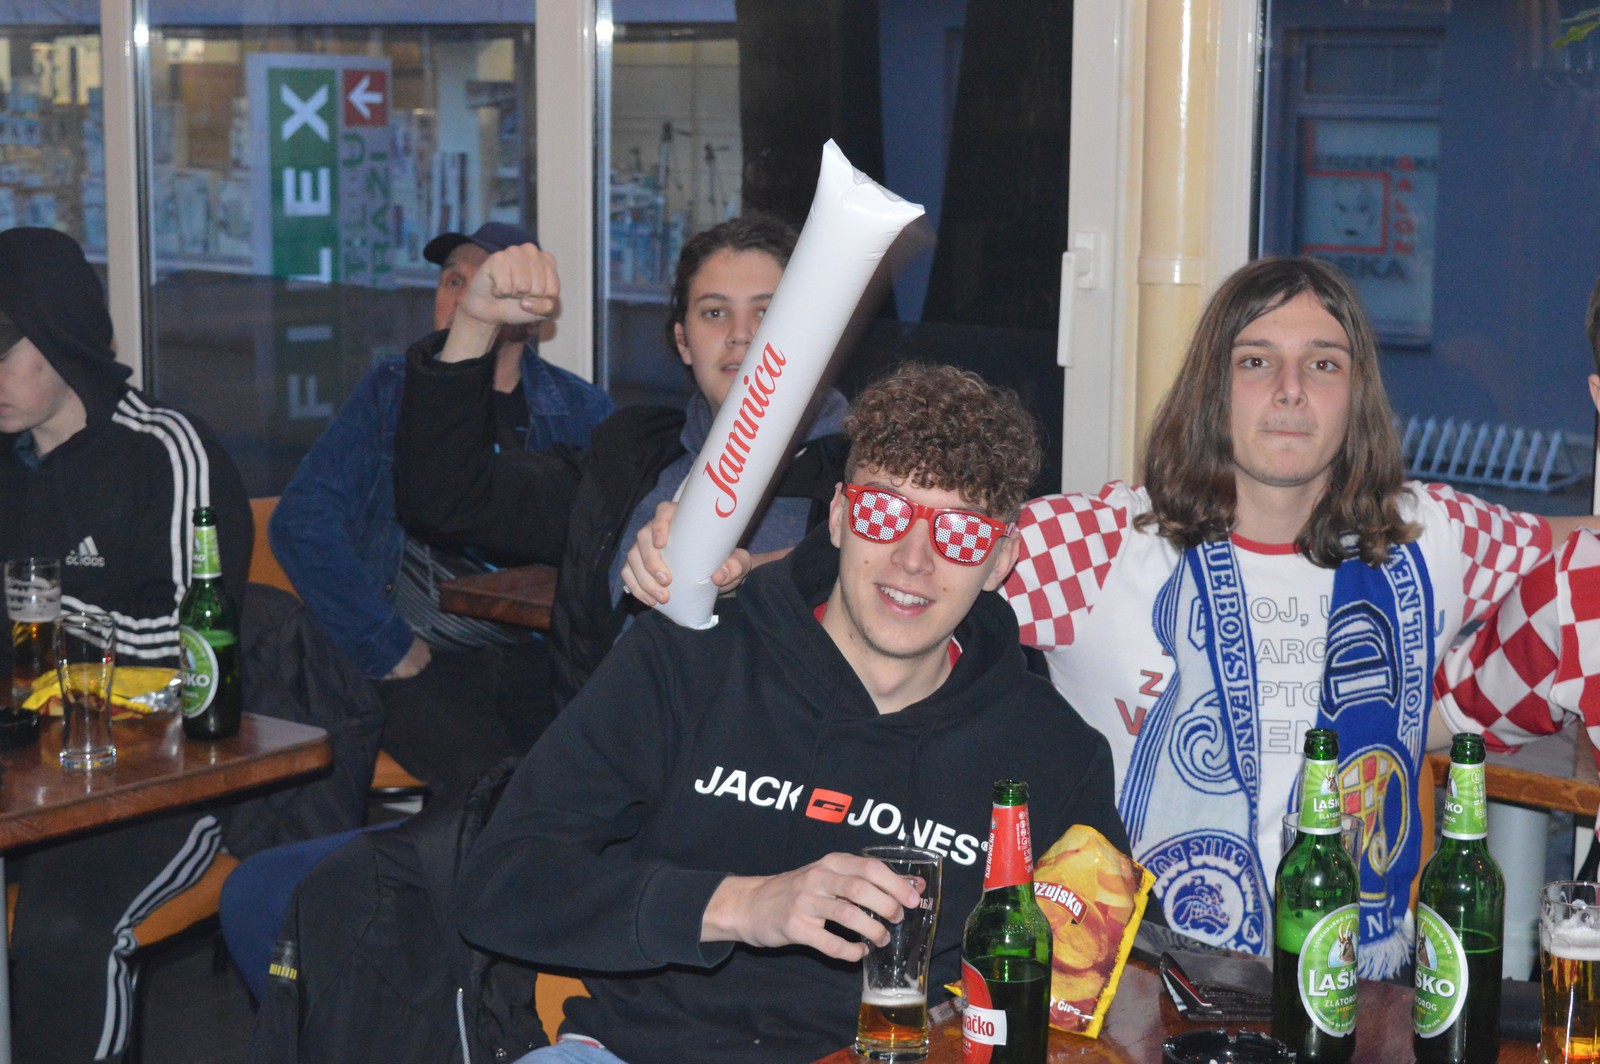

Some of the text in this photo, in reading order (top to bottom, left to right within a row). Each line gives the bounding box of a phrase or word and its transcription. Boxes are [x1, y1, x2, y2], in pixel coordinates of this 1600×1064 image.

[703, 342, 787, 518] Jamnica
[1214, 593, 1248, 680] BOYS
[1228, 688, 1255, 751] FAN
[694, 765, 804, 811] JACK
